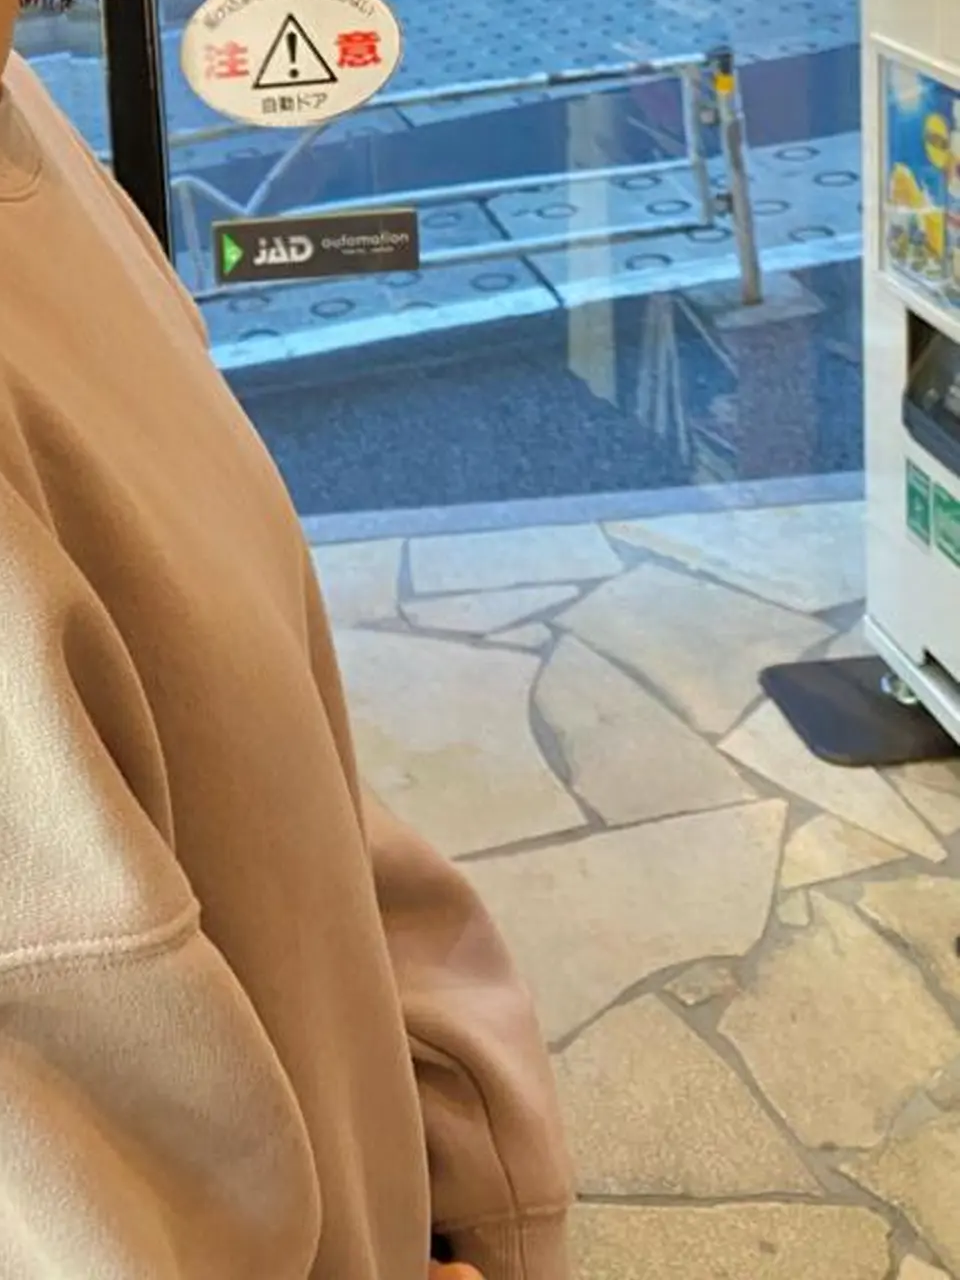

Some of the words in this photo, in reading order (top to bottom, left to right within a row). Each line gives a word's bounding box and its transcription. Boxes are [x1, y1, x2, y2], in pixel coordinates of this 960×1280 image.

[204, 41, 250, 80] 注
[335, 31, 382, 69] 意
[261, 92, 329, 114] 自動ドア
